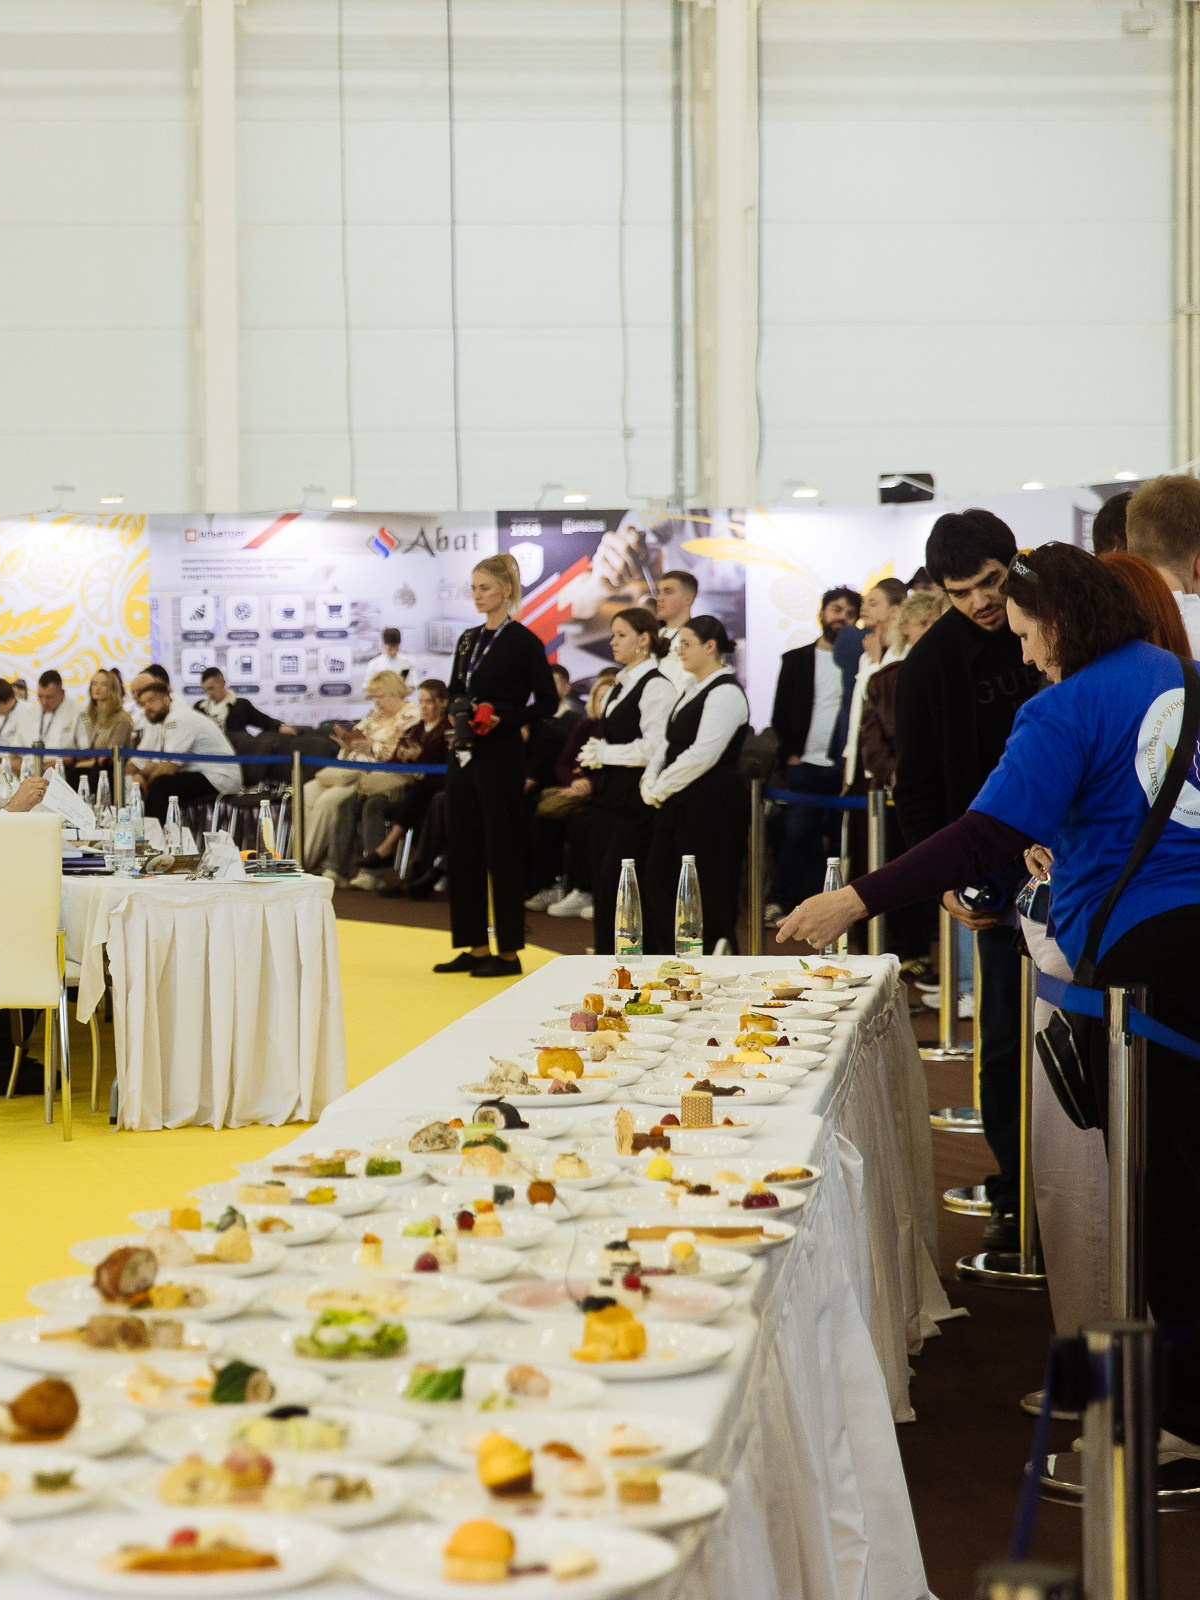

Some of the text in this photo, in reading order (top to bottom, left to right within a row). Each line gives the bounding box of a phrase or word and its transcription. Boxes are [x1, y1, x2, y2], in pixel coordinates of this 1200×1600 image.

[403, 526, 480, 558] Abat
[977, 668, 1043, 704] GUE
[1144, 719, 1164, 796] Балтийская
